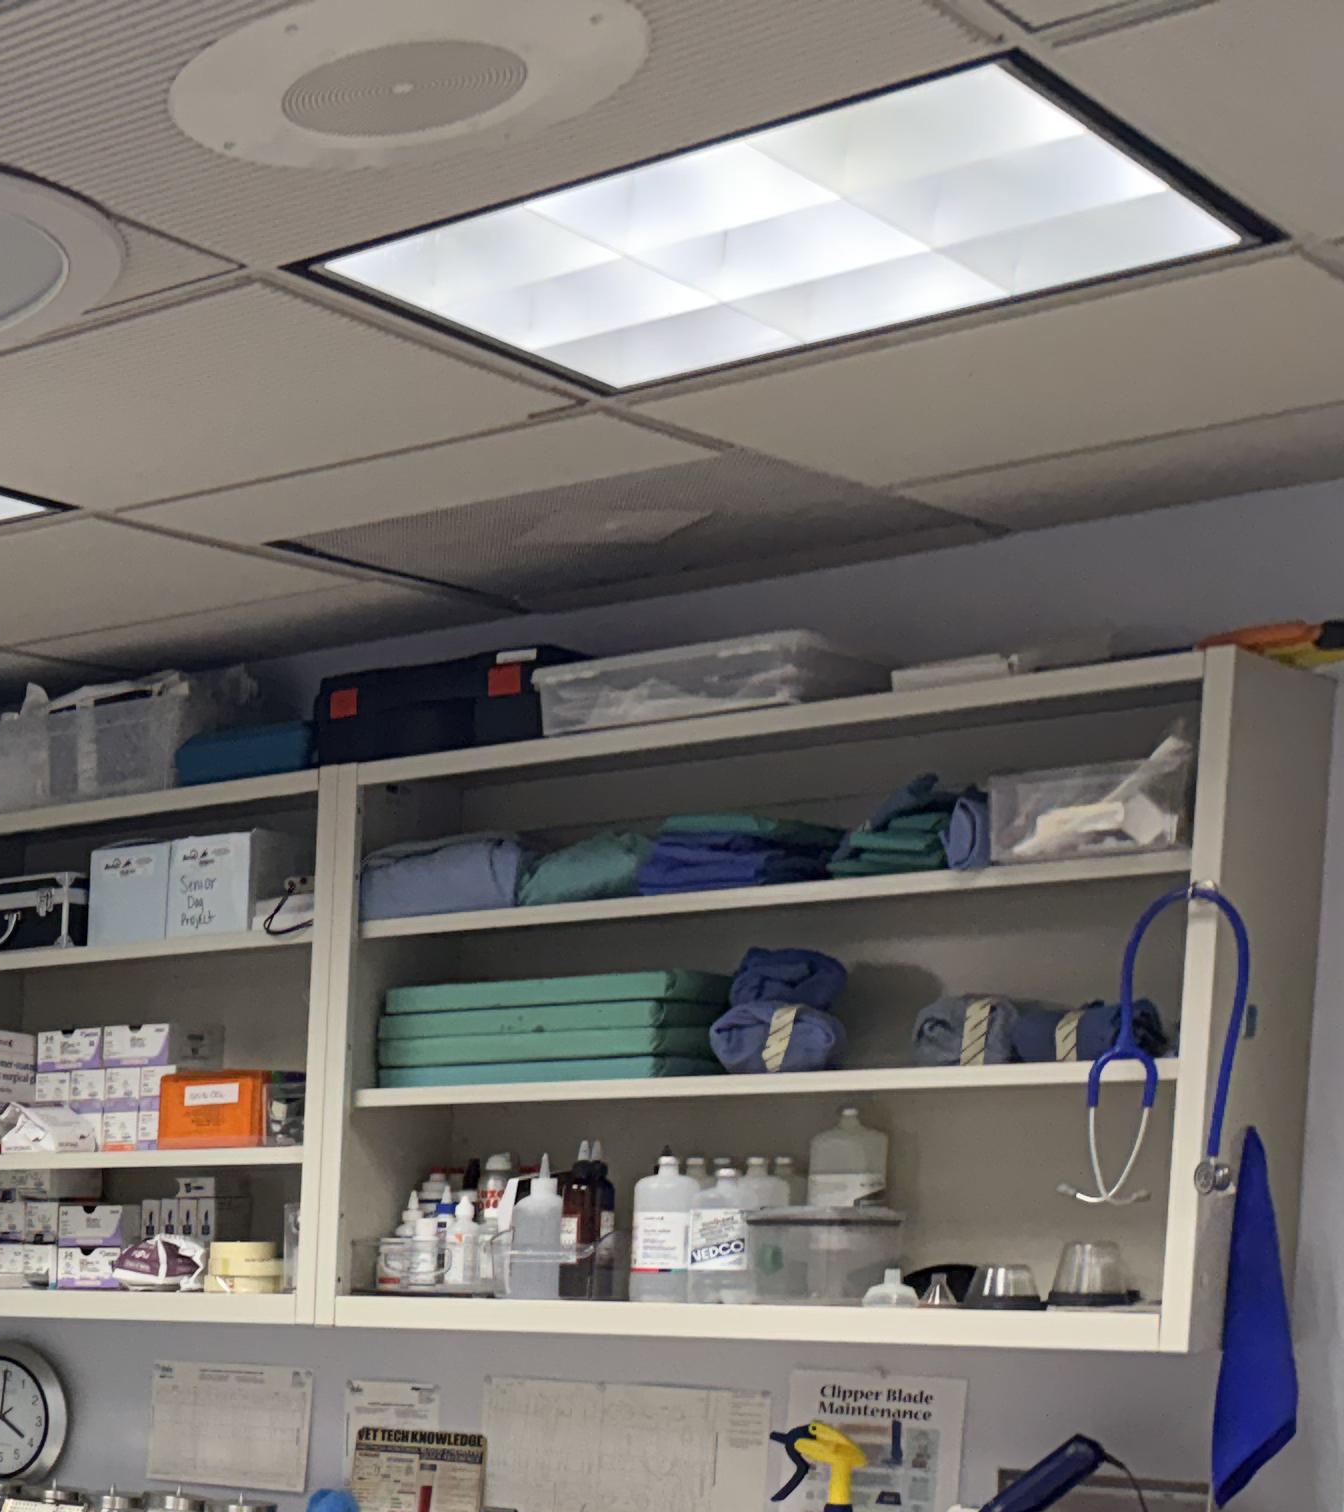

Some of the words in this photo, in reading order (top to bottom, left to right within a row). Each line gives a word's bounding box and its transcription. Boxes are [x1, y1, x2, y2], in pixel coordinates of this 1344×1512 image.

[180, 875, 217, 894] Senior
[692, 1240, 744, 1261] VEDCO
[31, 1395, 40, 1406] 2
[820, 1384, 883, 1402] Clipper
[886, 1387, 934, 1406] Blade
[818, 1400, 933, 1421] Maintenance
[35, 1415, 43, 1428] 3
[358, 1427, 379, 1441] VET
[380, 1429, 410, 1443] TECH
[410, 1431, 483, 1448] KNOWLEDGE
[13, 1448, 21, 1461] 5
